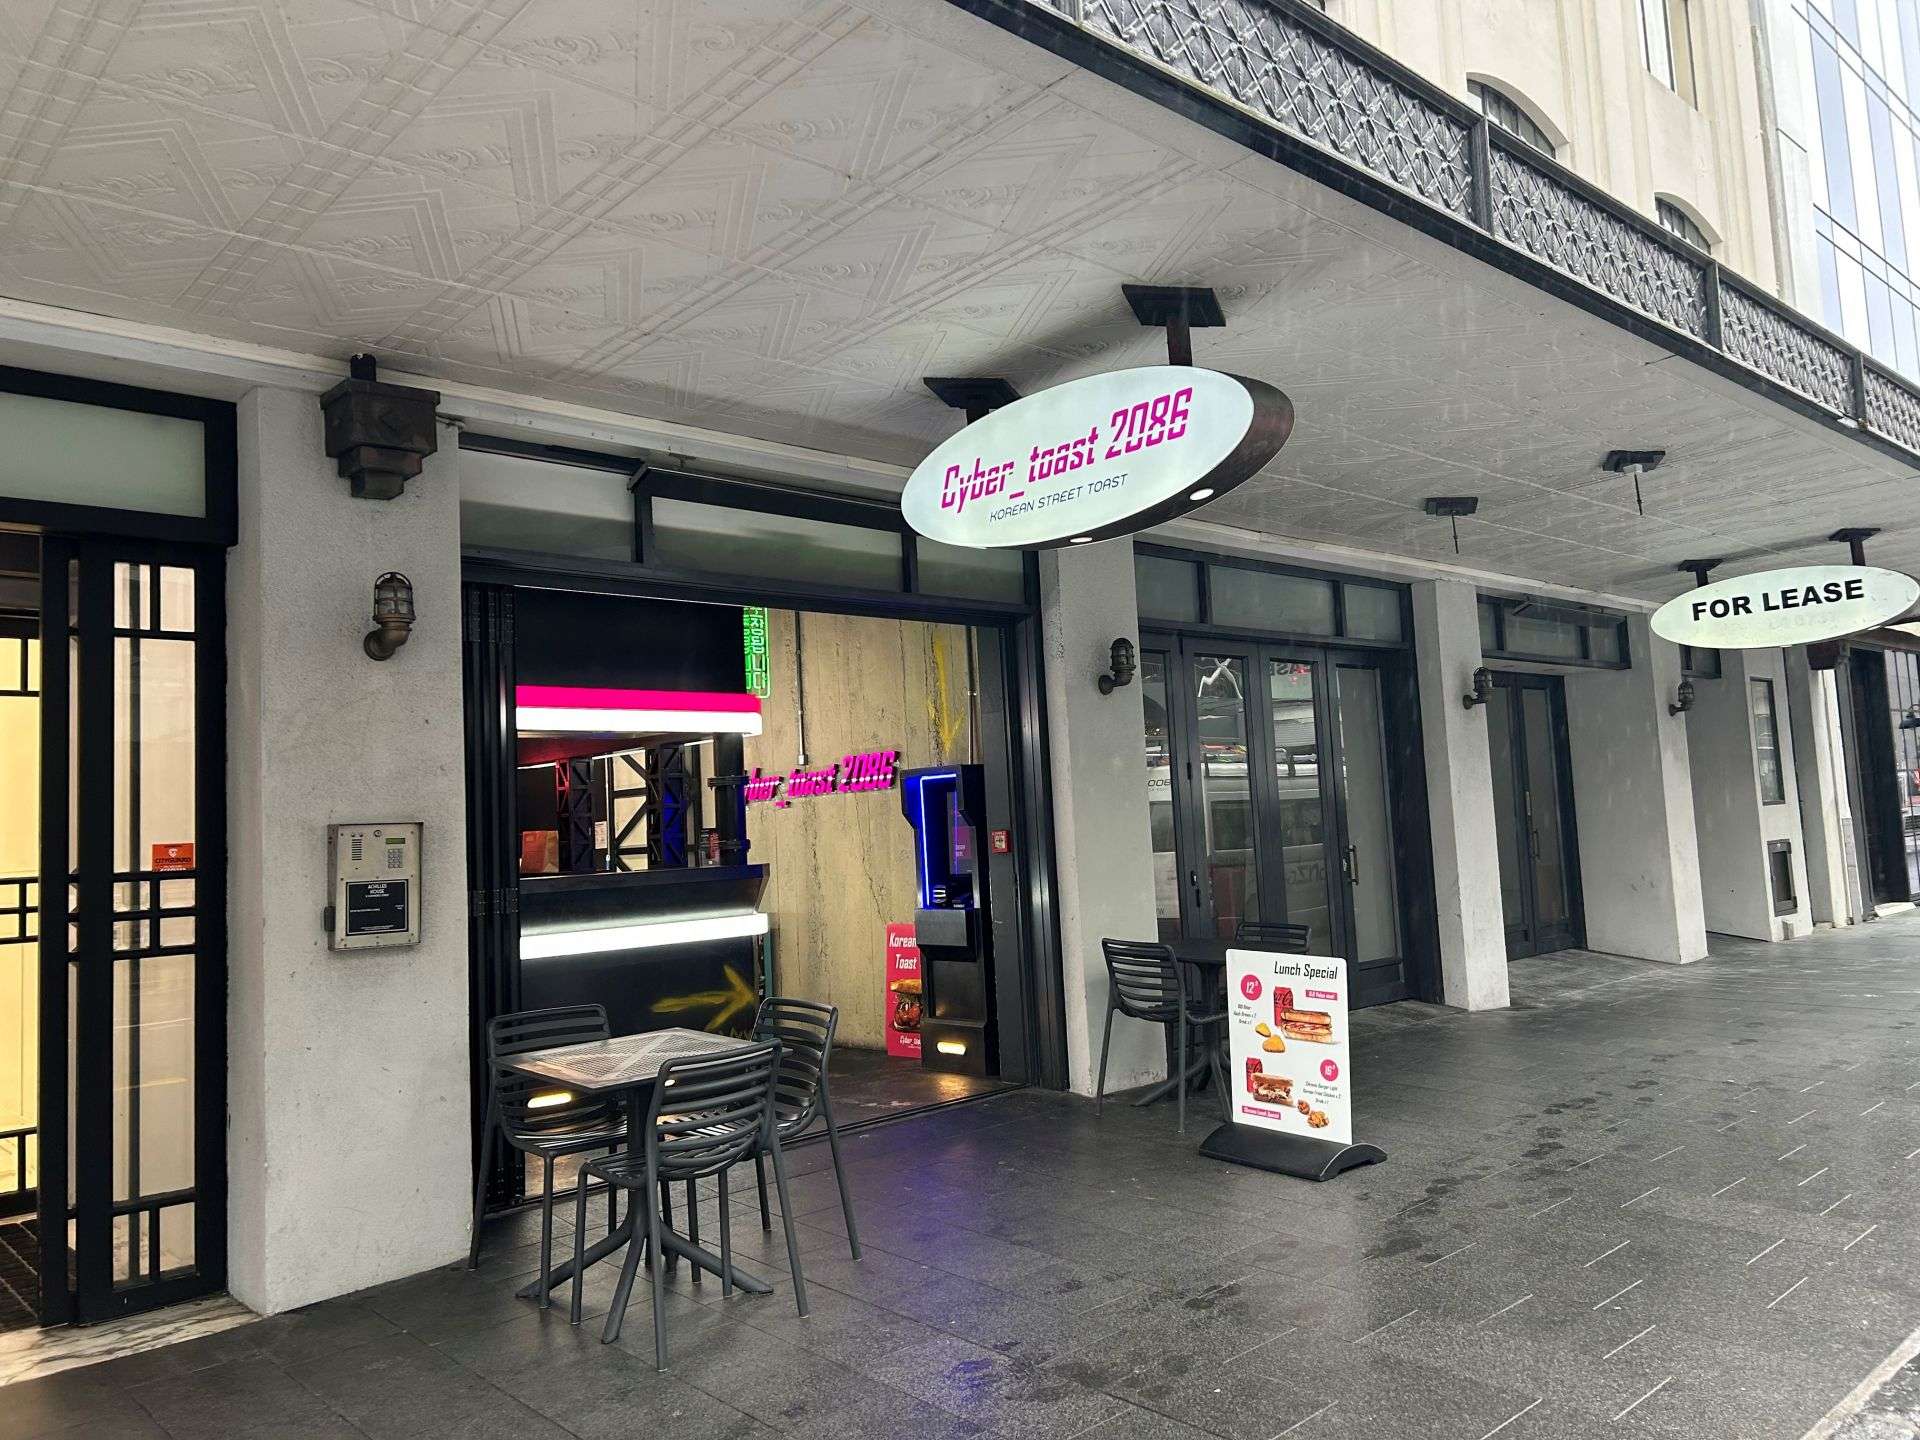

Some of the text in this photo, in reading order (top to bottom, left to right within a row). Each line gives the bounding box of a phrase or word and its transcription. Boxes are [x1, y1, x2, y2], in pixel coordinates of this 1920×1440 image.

[1105, 387, 1193, 460] 2086
[989, 473, 1128, 523] KOREAN STREET TOAST
[1692, 578, 1864, 621] FOR LEASE
[839, 750, 899, 793] 2086
[889, 932, 917, 948] Korean
[895, 954, 917, 970] Toast
[1273, 961, 1338, 980] Lunch Special
